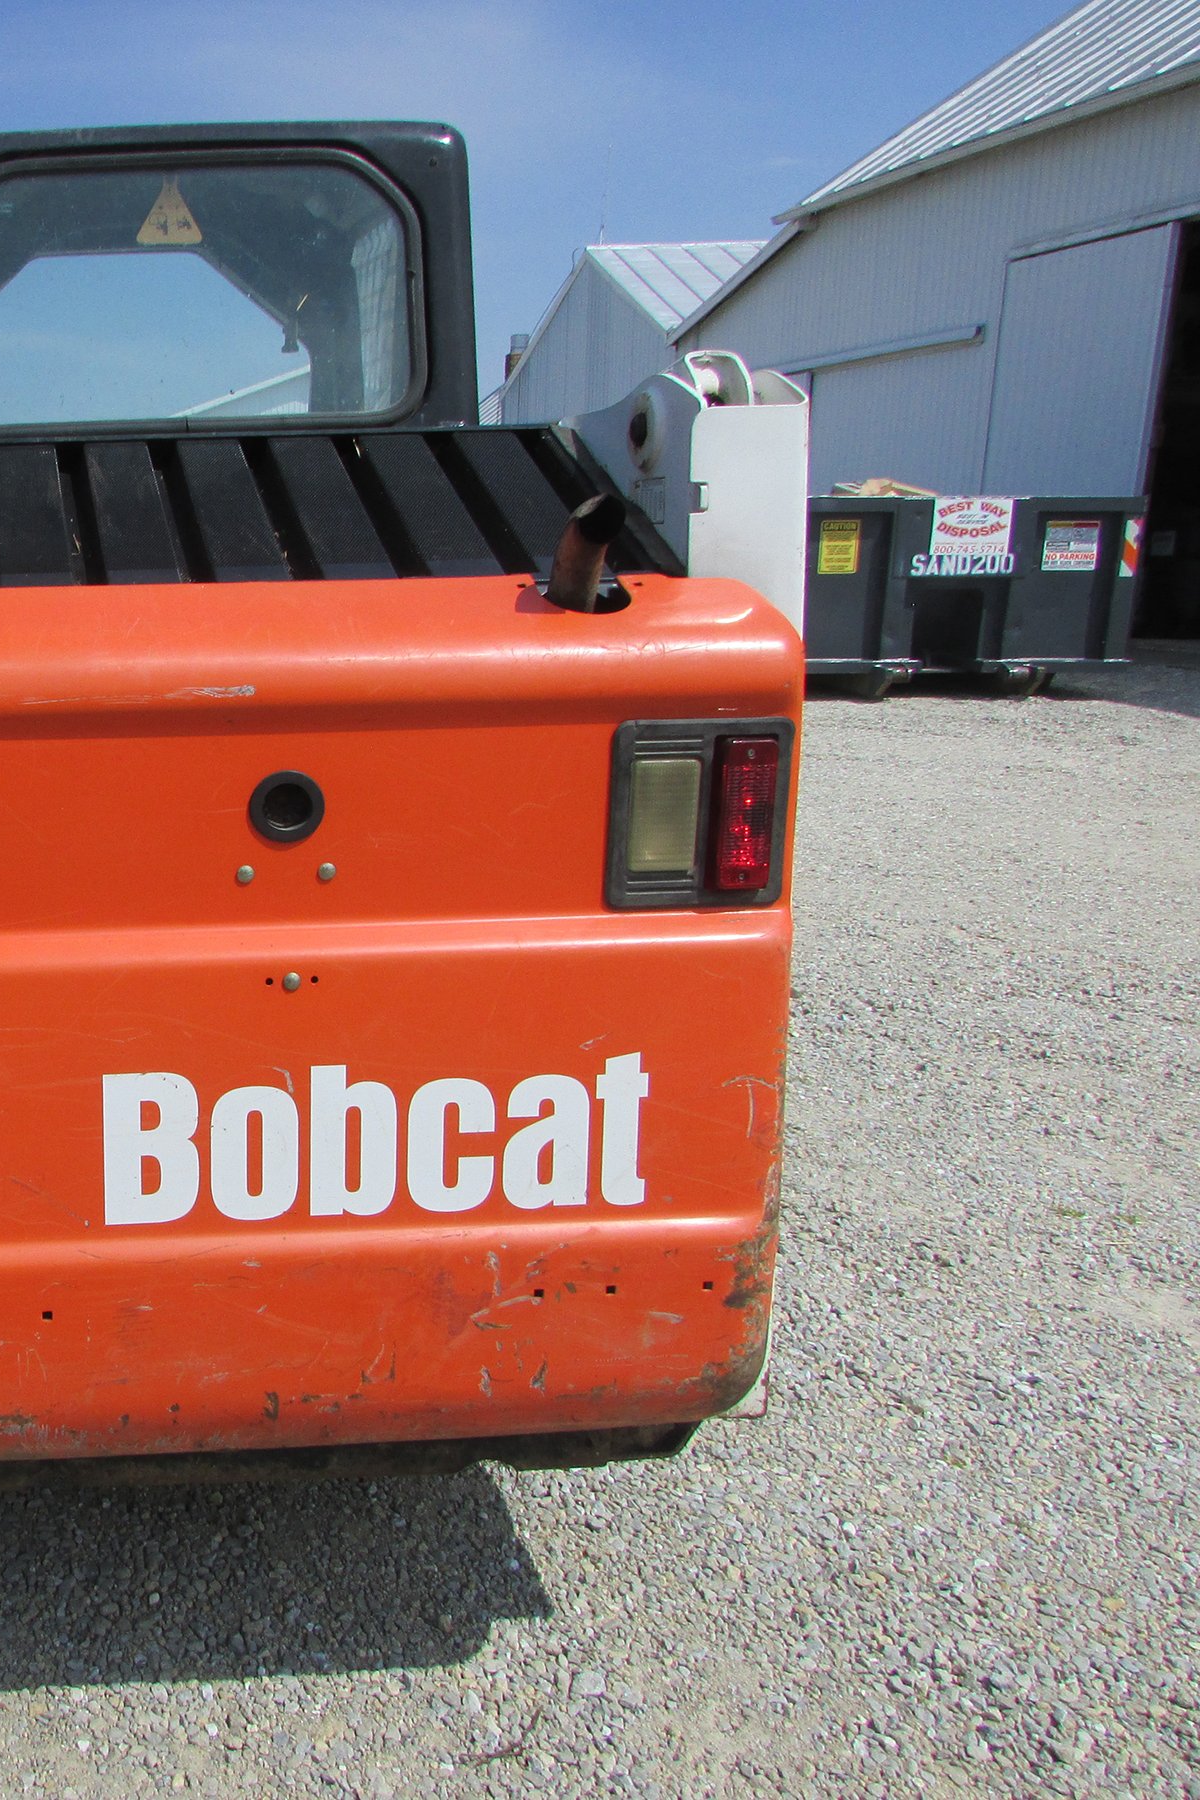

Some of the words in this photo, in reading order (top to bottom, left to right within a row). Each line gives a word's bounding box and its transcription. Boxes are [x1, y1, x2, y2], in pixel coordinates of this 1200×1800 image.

[938, 501, 974, 518] BEST
[980, 502, 1008, 518] WAY
[823, 522, 857, 530] CAUTION
[937, 521, 1008, 538] DISPOSAL
[933, 545, 1005, 554] 800-745-5714
[1045, 553, 1057, 561] NO
[1059, 553, 1095, 561] PARKING
[910, 553, 1015, 577] SAND200
[102, 1052, 649, 1226] Bobcat
